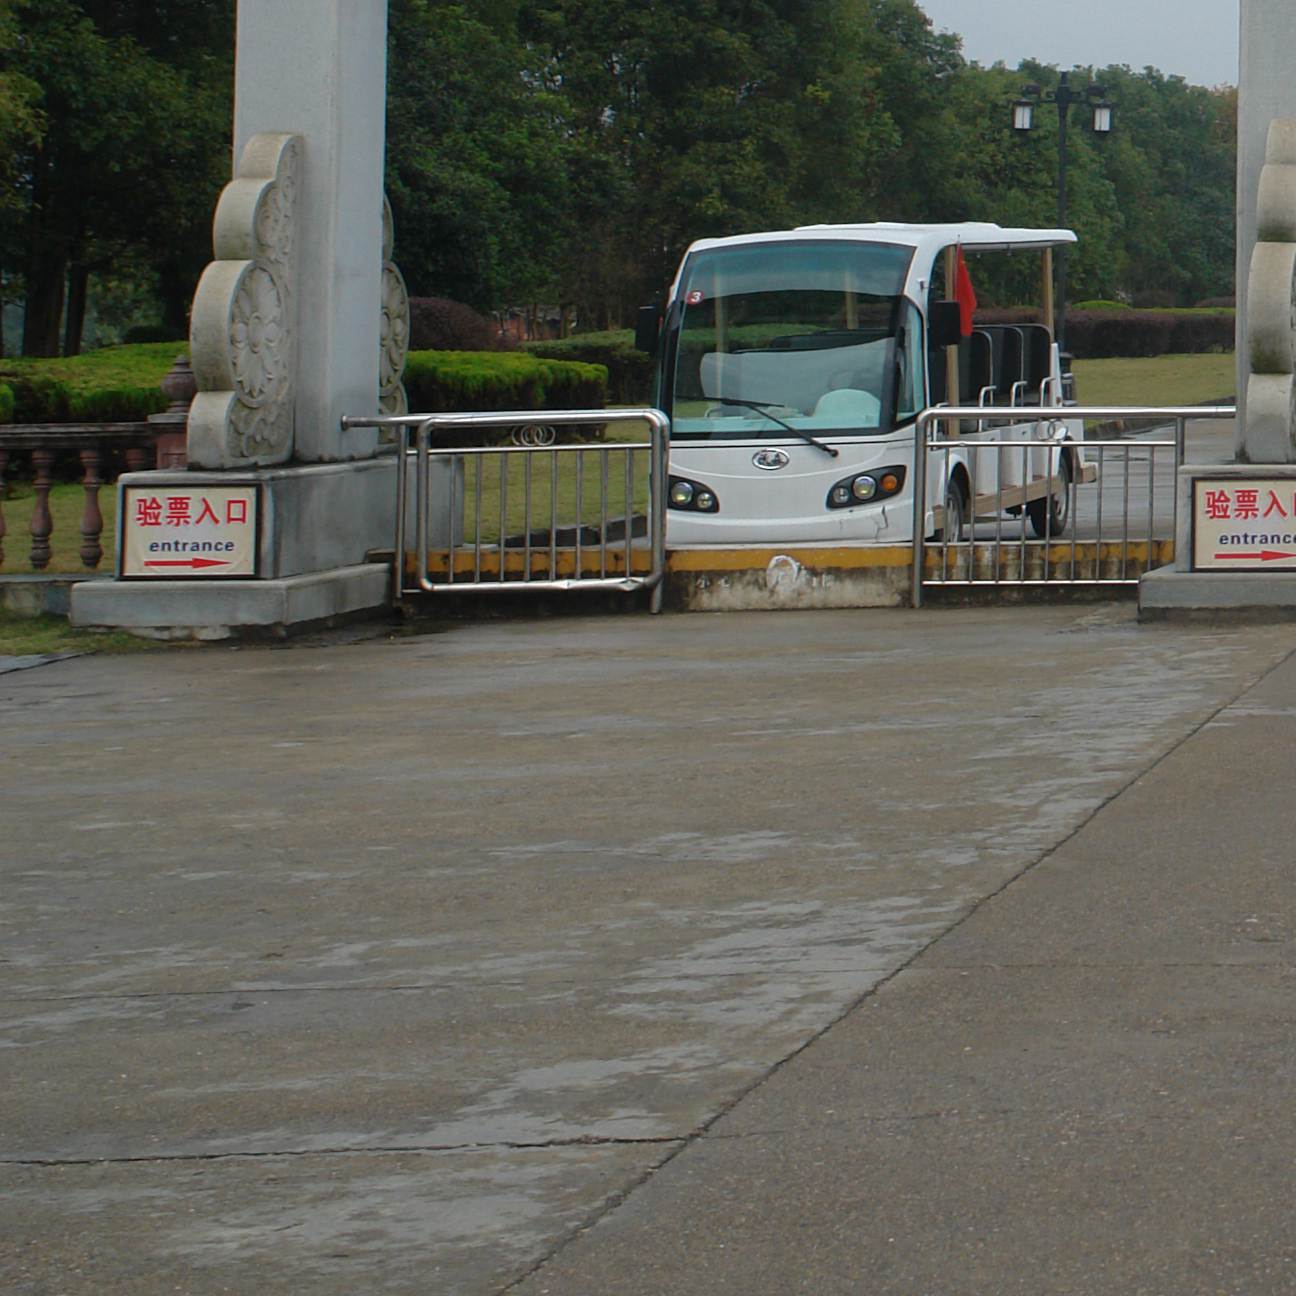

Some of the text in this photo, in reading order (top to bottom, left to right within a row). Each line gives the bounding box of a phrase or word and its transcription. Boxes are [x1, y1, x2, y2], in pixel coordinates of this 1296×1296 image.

[136, 496, 248, 527] 验票入口
[149, 540, 235, 552] entrance
